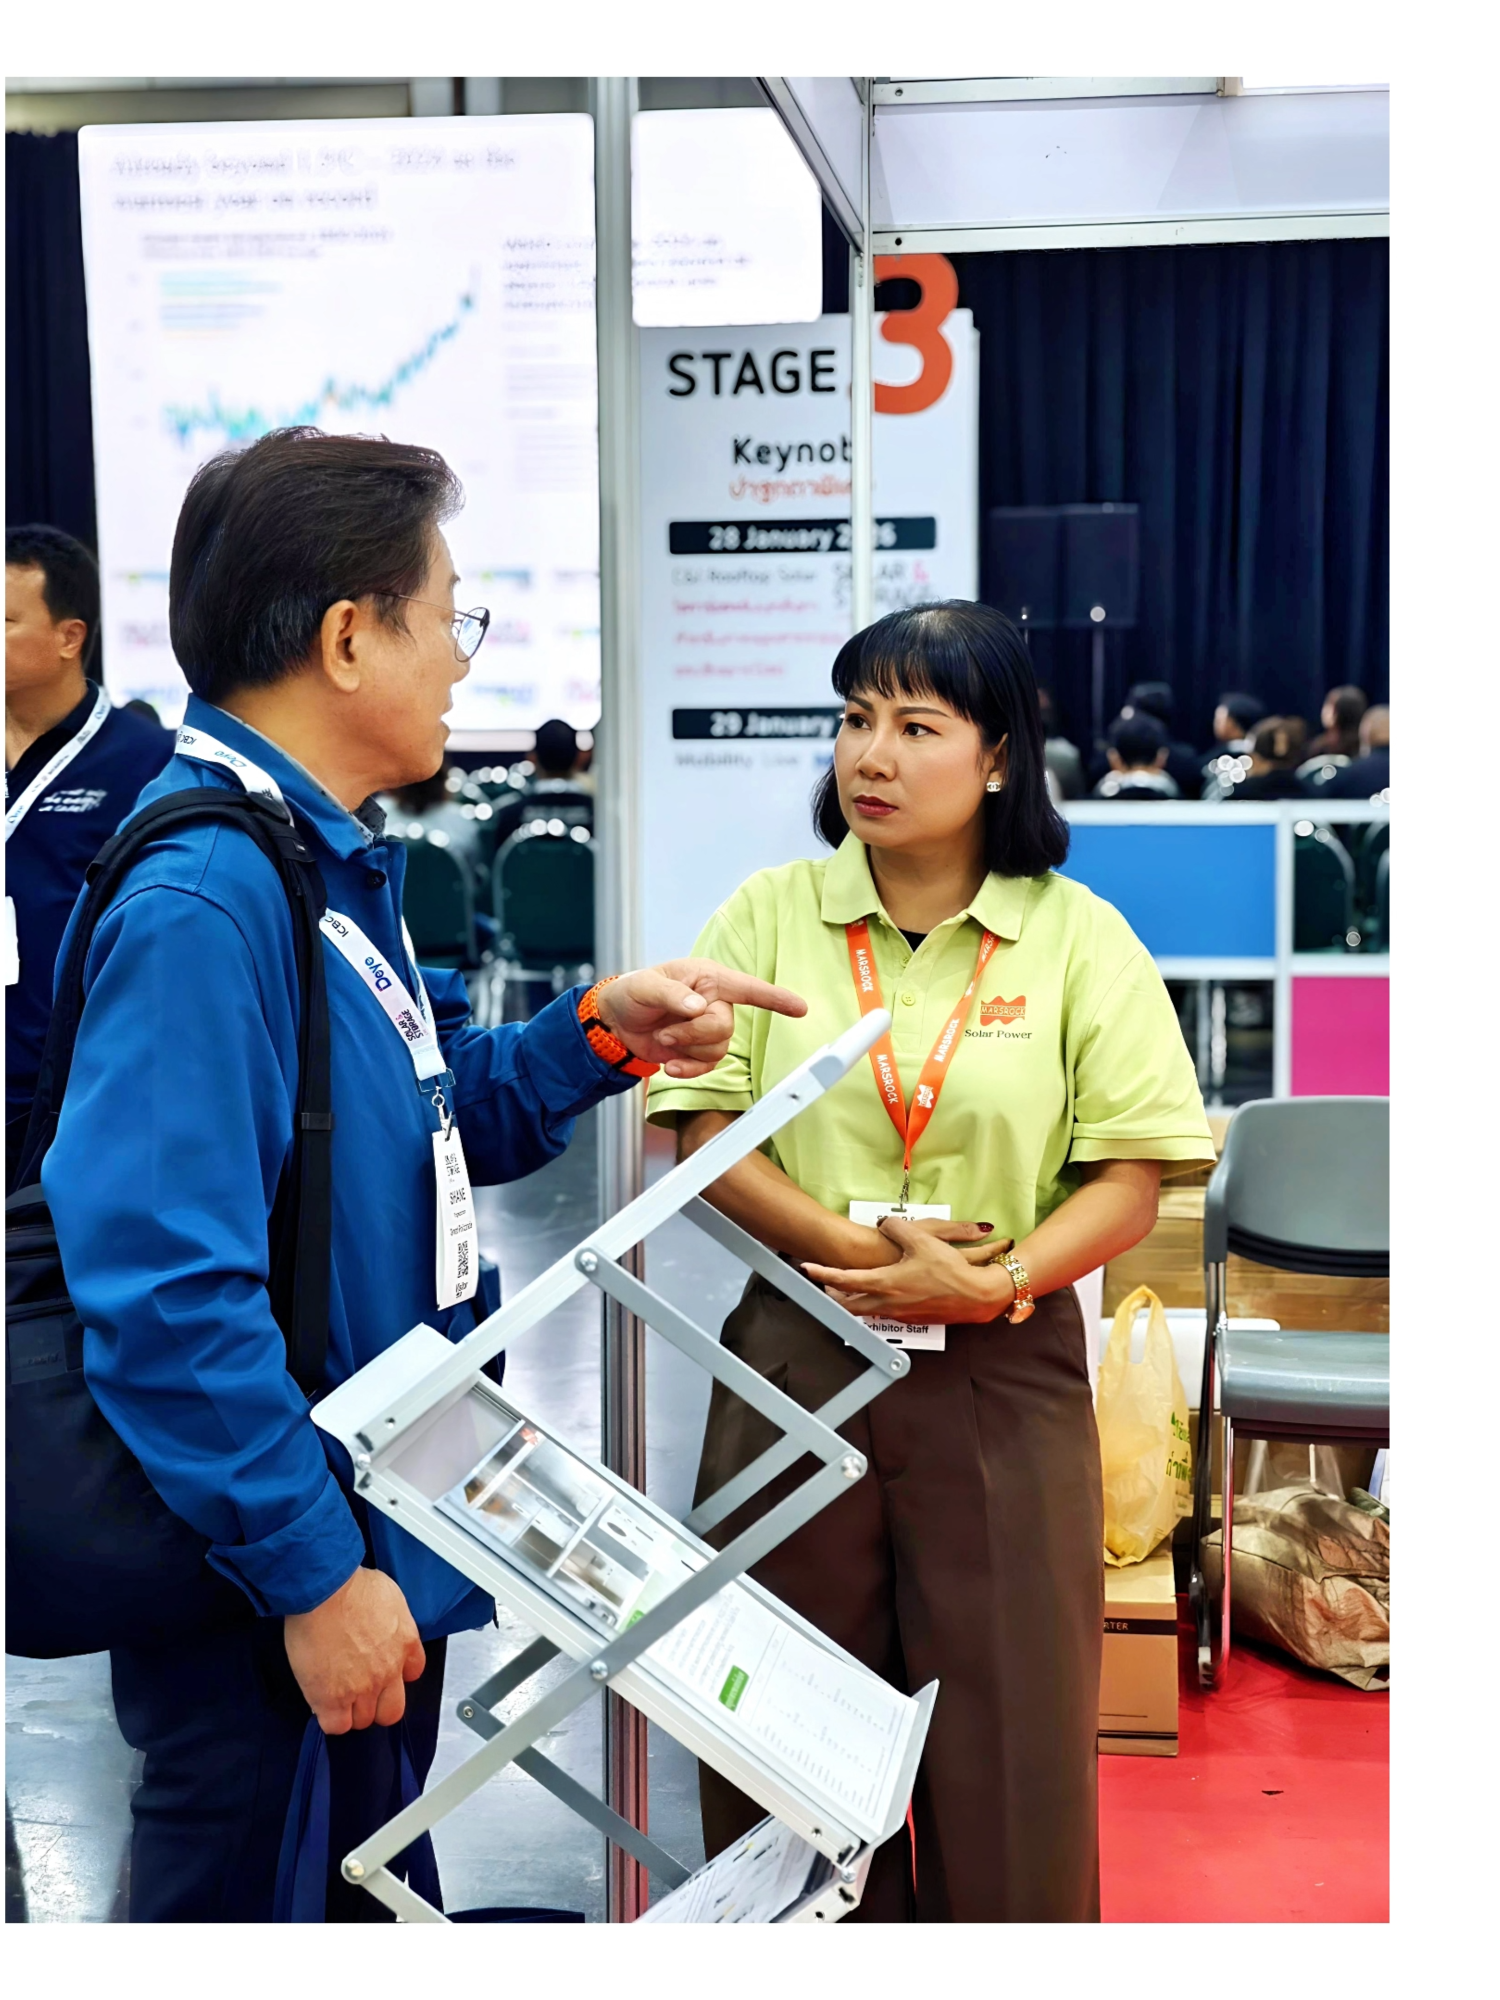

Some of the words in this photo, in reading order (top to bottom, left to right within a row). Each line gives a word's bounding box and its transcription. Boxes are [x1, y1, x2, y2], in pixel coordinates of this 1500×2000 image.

[669, 350, 836, 397] STAGE
[849, 252, 958, 415] 3
[709, 525, 741, 549] 28
[743, 524, 836, 552] January
[710, 711, 743, 737] 29
[325, 916, 349, 938] ICBC
[364, 956, 392, 992] Deye
[856, 948, 874, 993] MARSROCK
[981, 1006, 1025, 1015] MARSROCK
[934, 1018, 960, 1062] MARSROCK
[965, 1029, 993, 1037] Solar
[997, 1030, 1032, 1039] Power
[876, 1054, 899, 1105] MARSROCK
[906, 1324, 928, 1334] Staff
